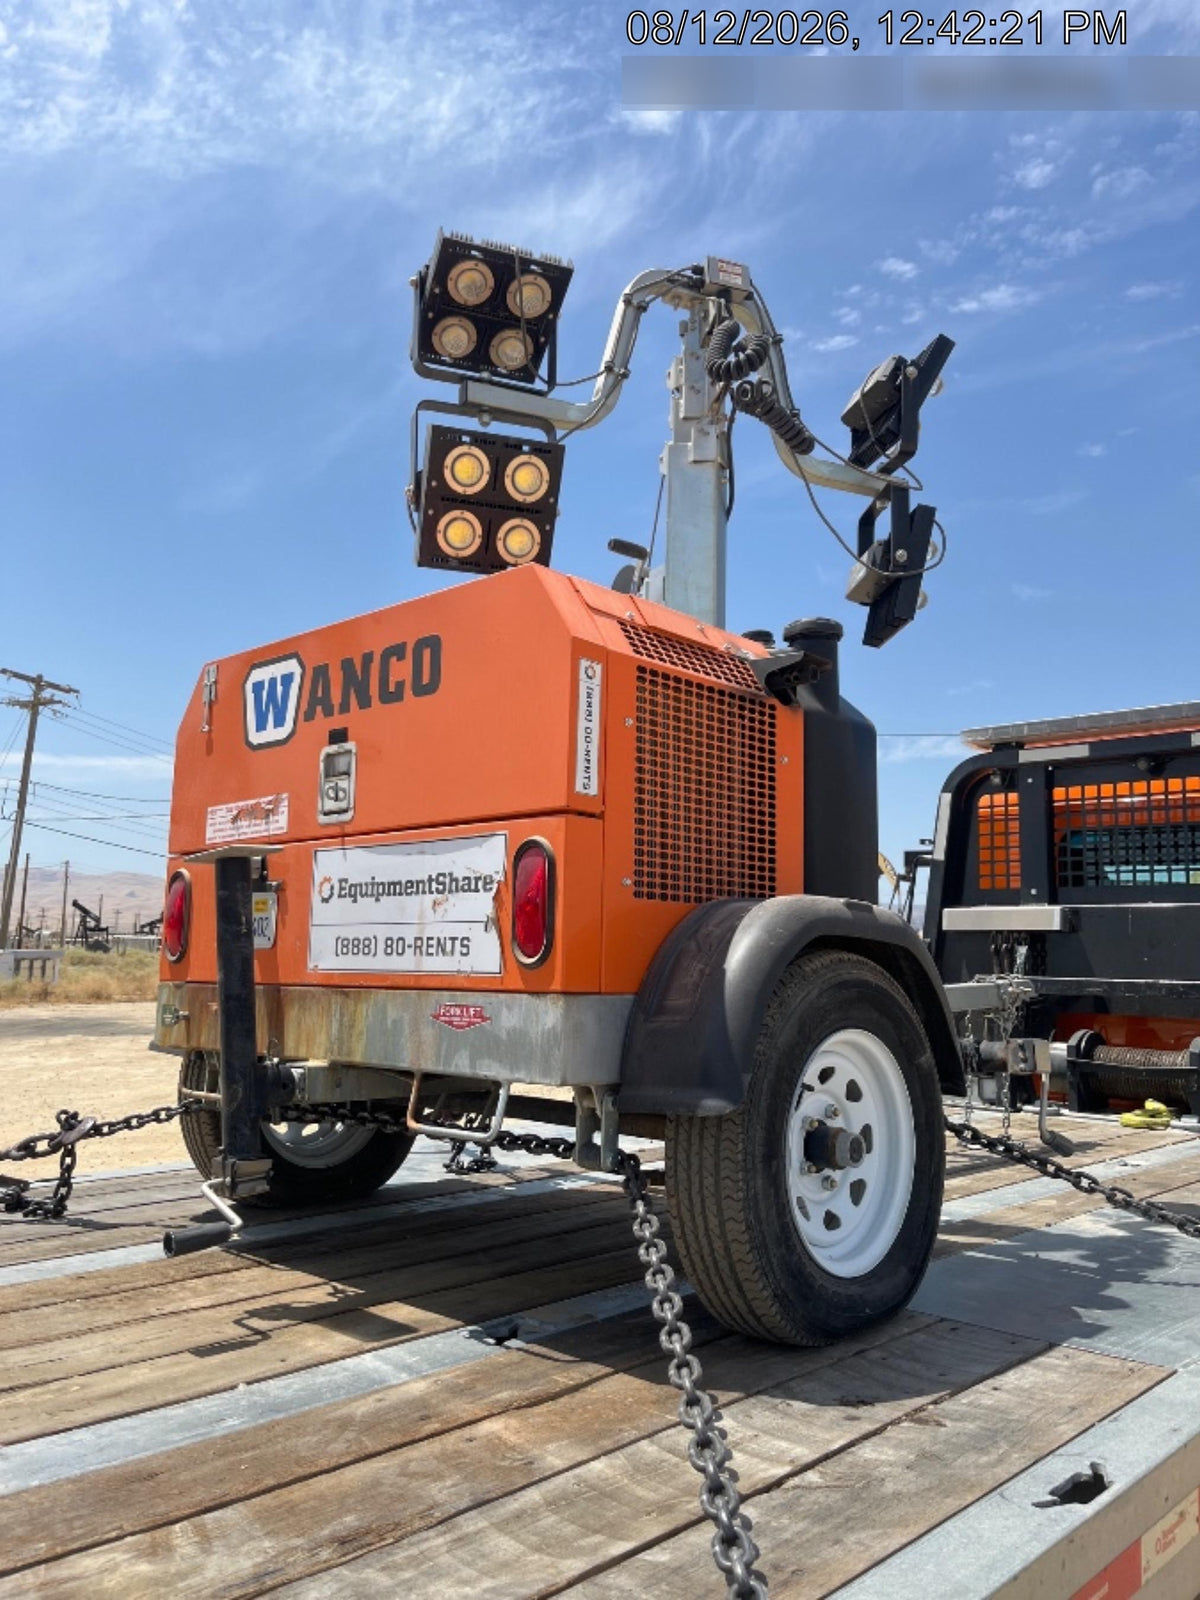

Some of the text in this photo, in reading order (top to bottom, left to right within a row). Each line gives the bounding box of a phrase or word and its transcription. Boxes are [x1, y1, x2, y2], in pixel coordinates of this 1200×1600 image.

[250, 634, 442, 734] WANCO
[335, 936, 471, 958] (888) 80-RENTS
